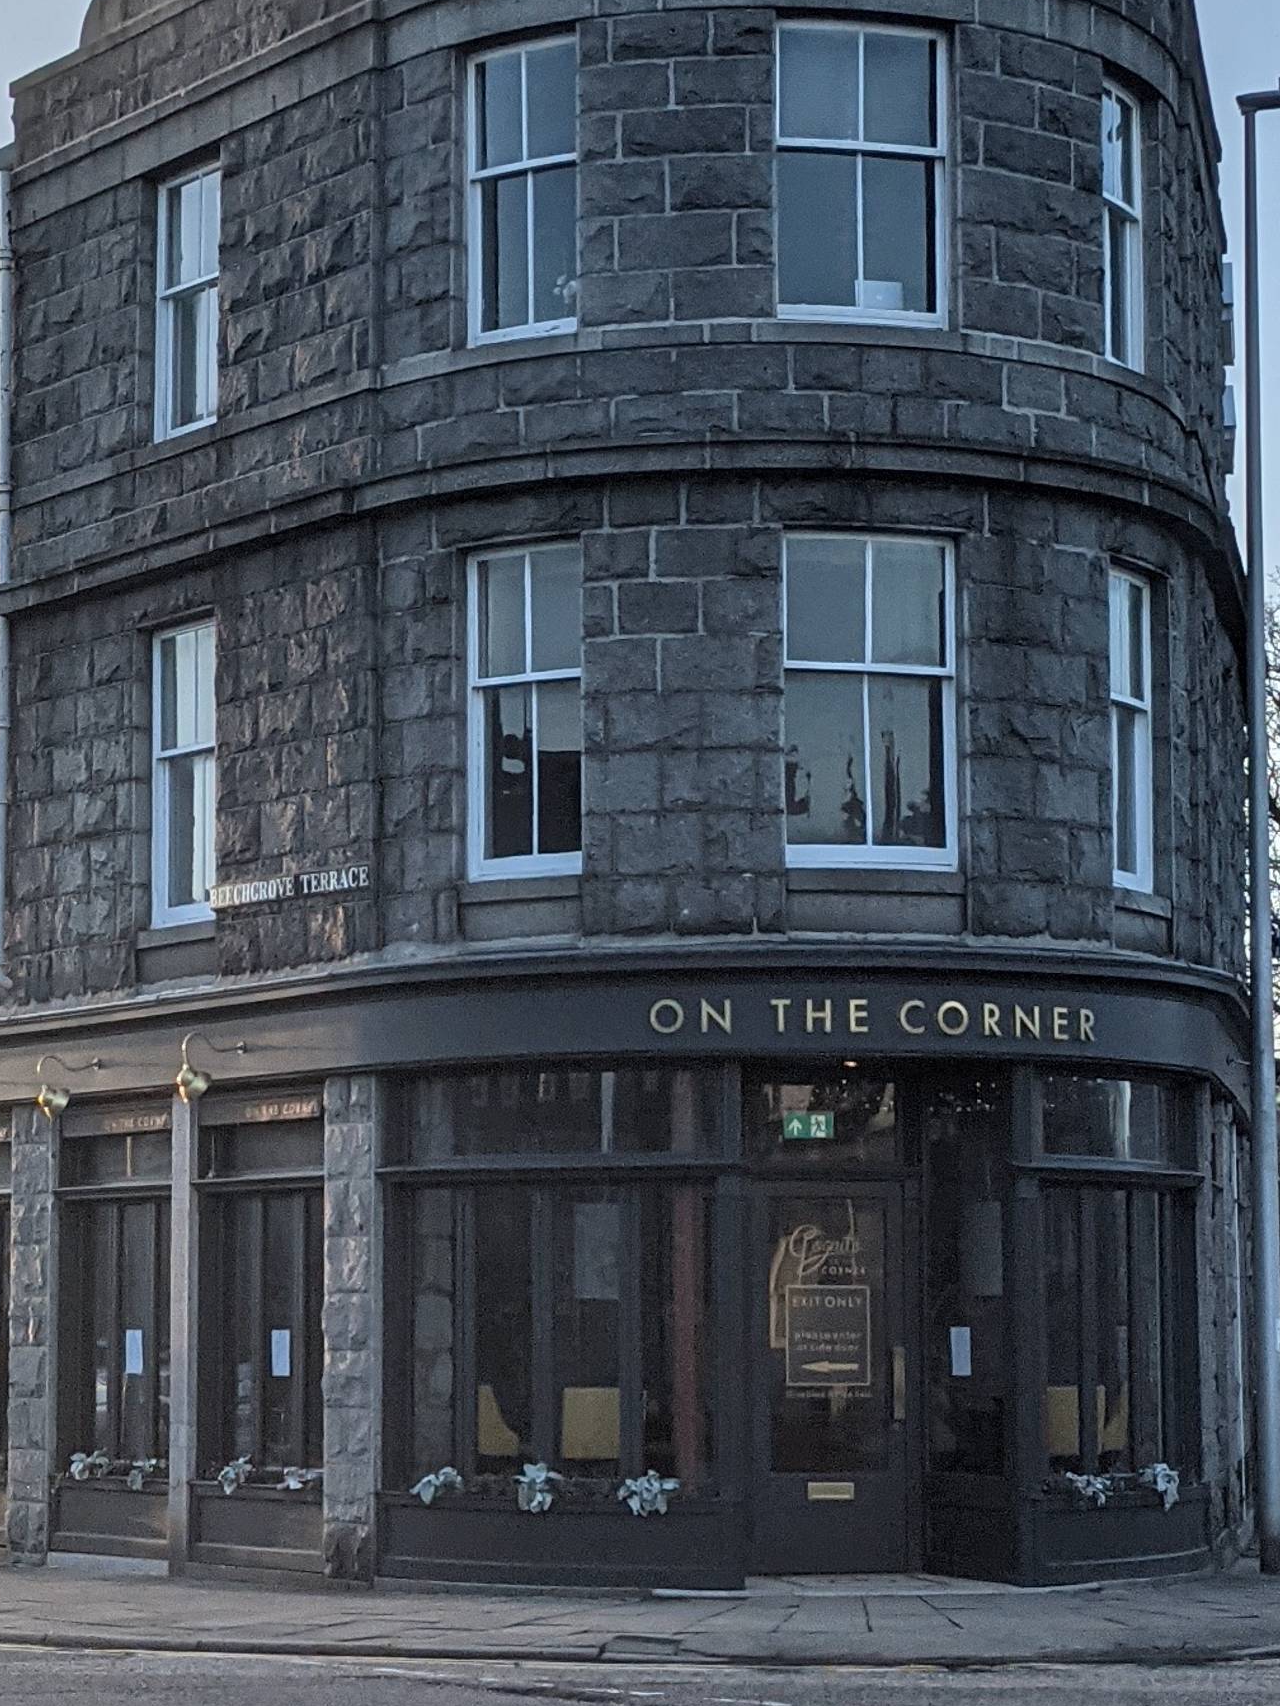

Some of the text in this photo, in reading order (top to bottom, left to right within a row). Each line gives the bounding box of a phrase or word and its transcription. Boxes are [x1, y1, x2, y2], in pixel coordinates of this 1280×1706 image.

[209, 866, 370, 908] BEECHGROVE TERRACE
[649, 998, 1096, 1041] ON THE CORNER
[792, 1295, 862, 1308] EXIT ONLY
